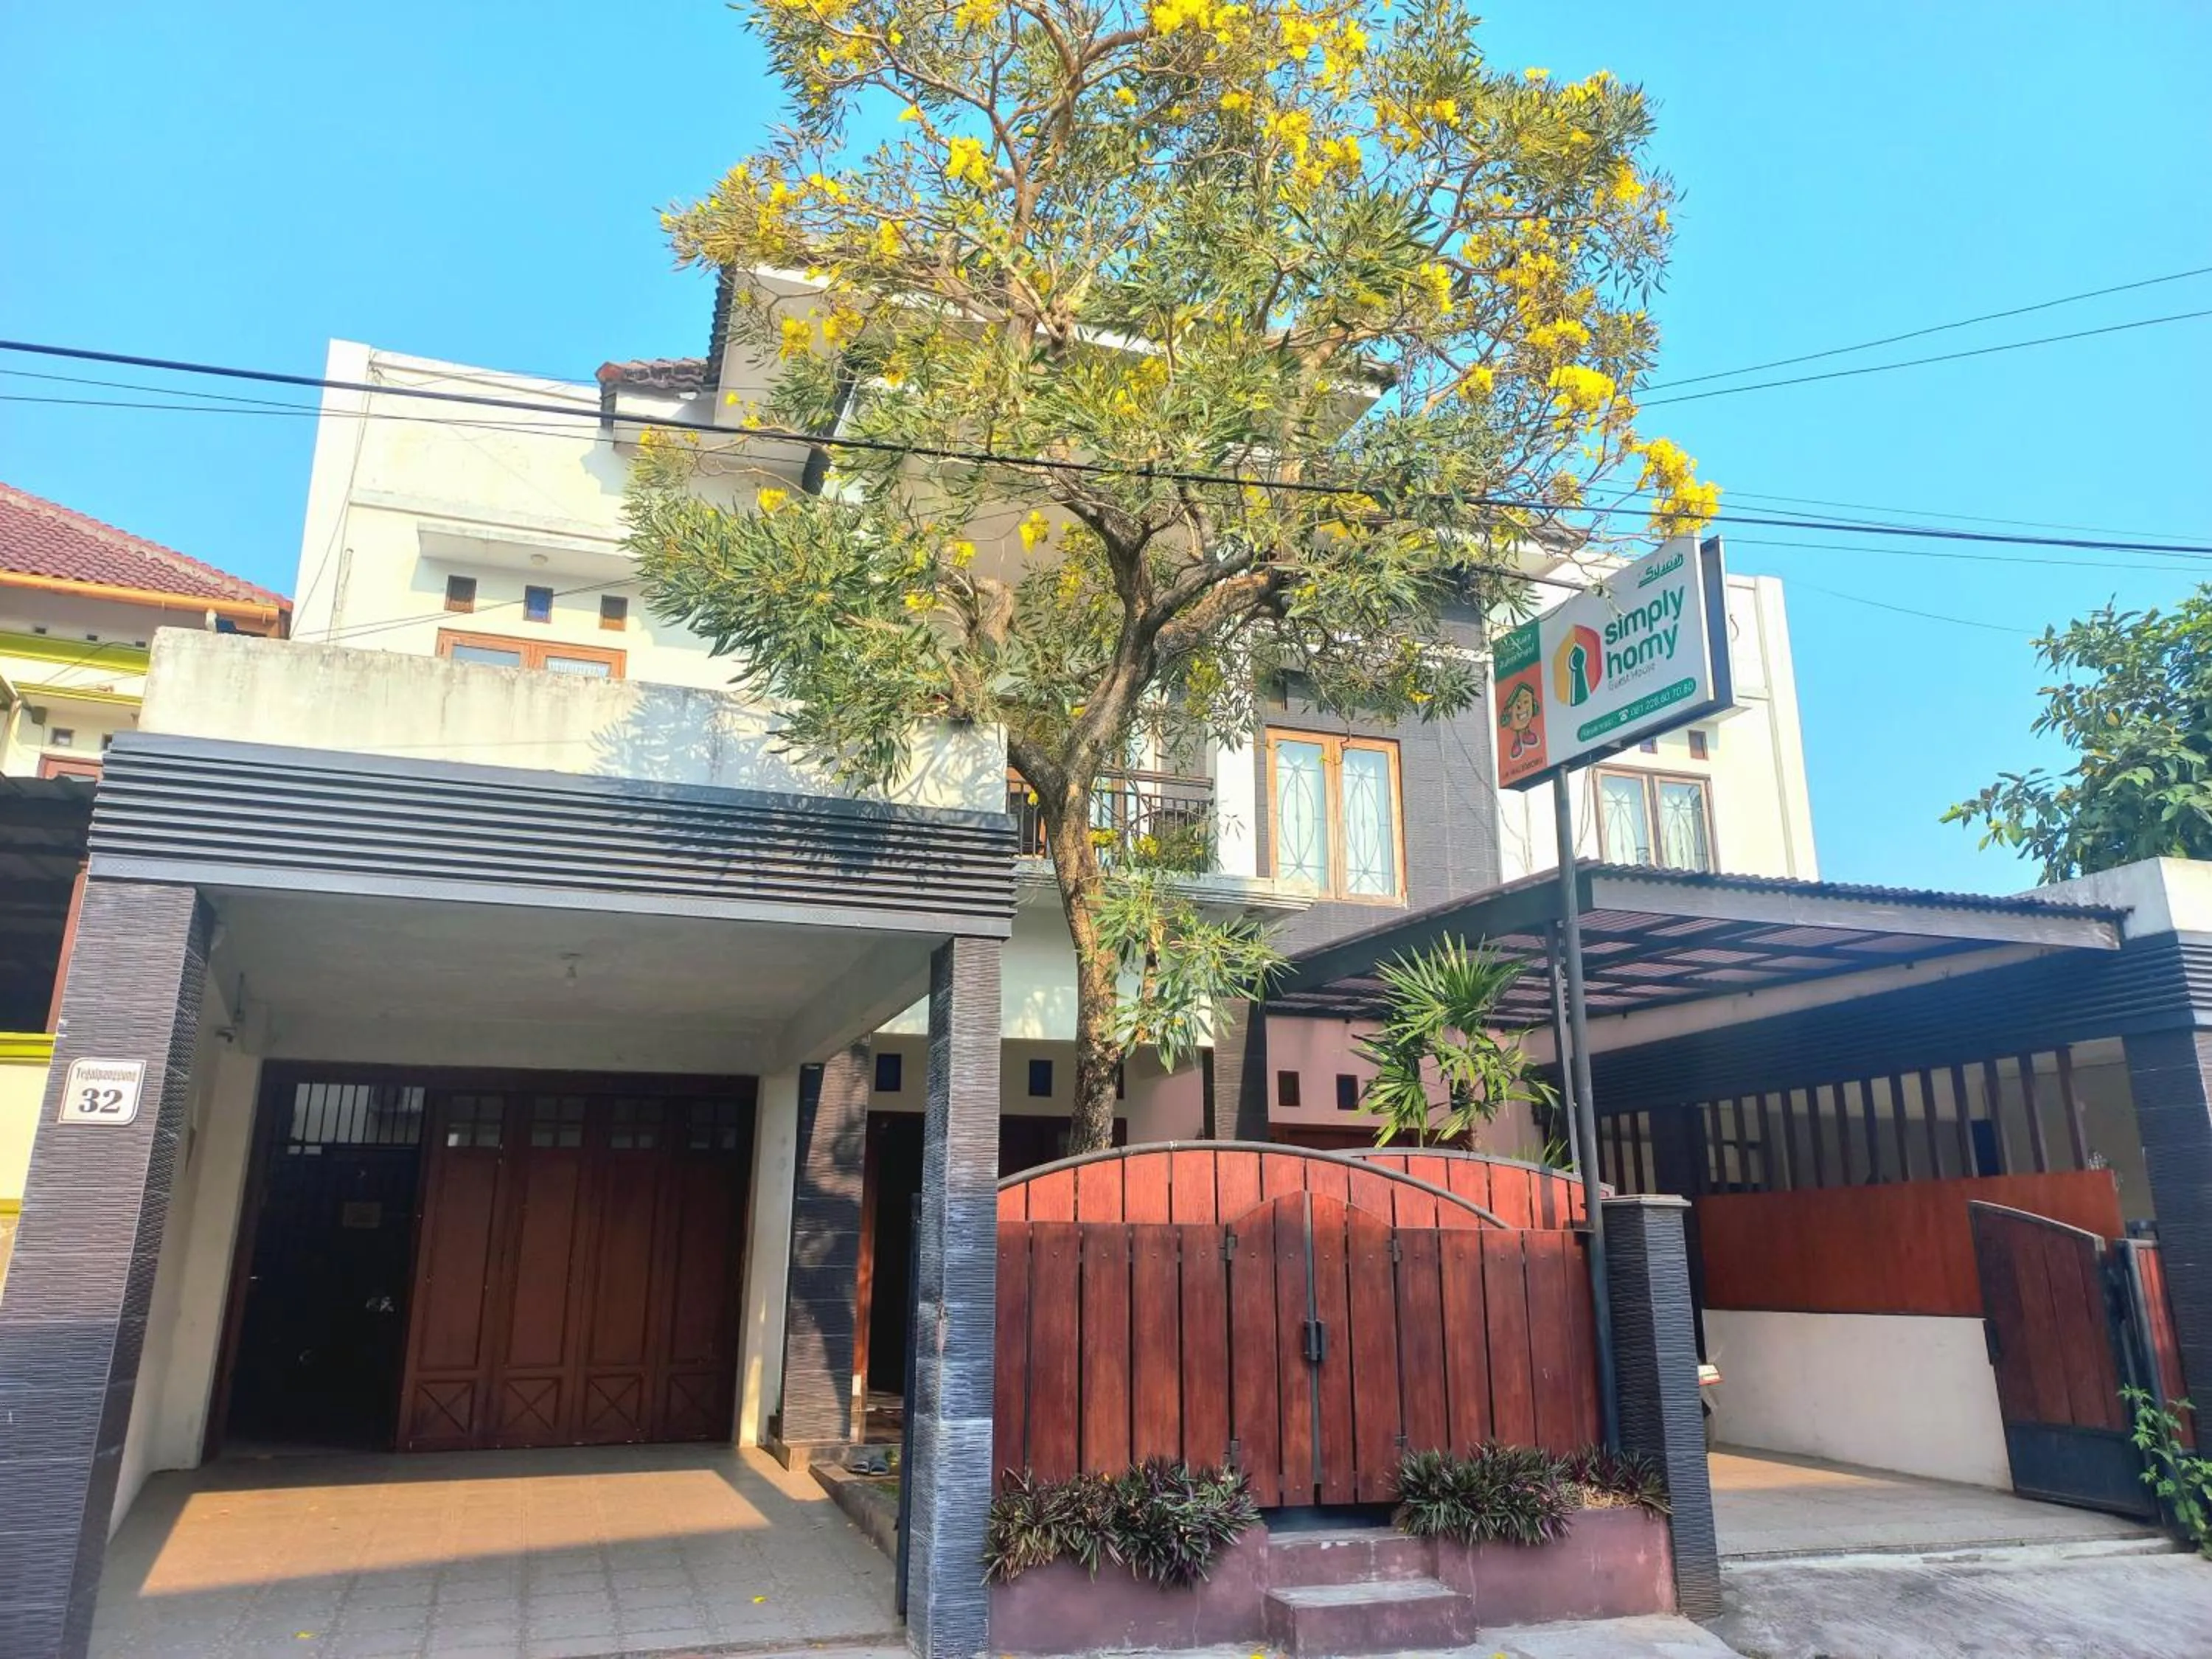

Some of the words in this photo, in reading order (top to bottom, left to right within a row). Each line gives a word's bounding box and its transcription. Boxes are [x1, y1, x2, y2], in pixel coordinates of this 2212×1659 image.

[1604, 585, 1685, 645] simply
[1605, 623, 1679, 679] homy
[78, 1088, 123, 1113] 32
